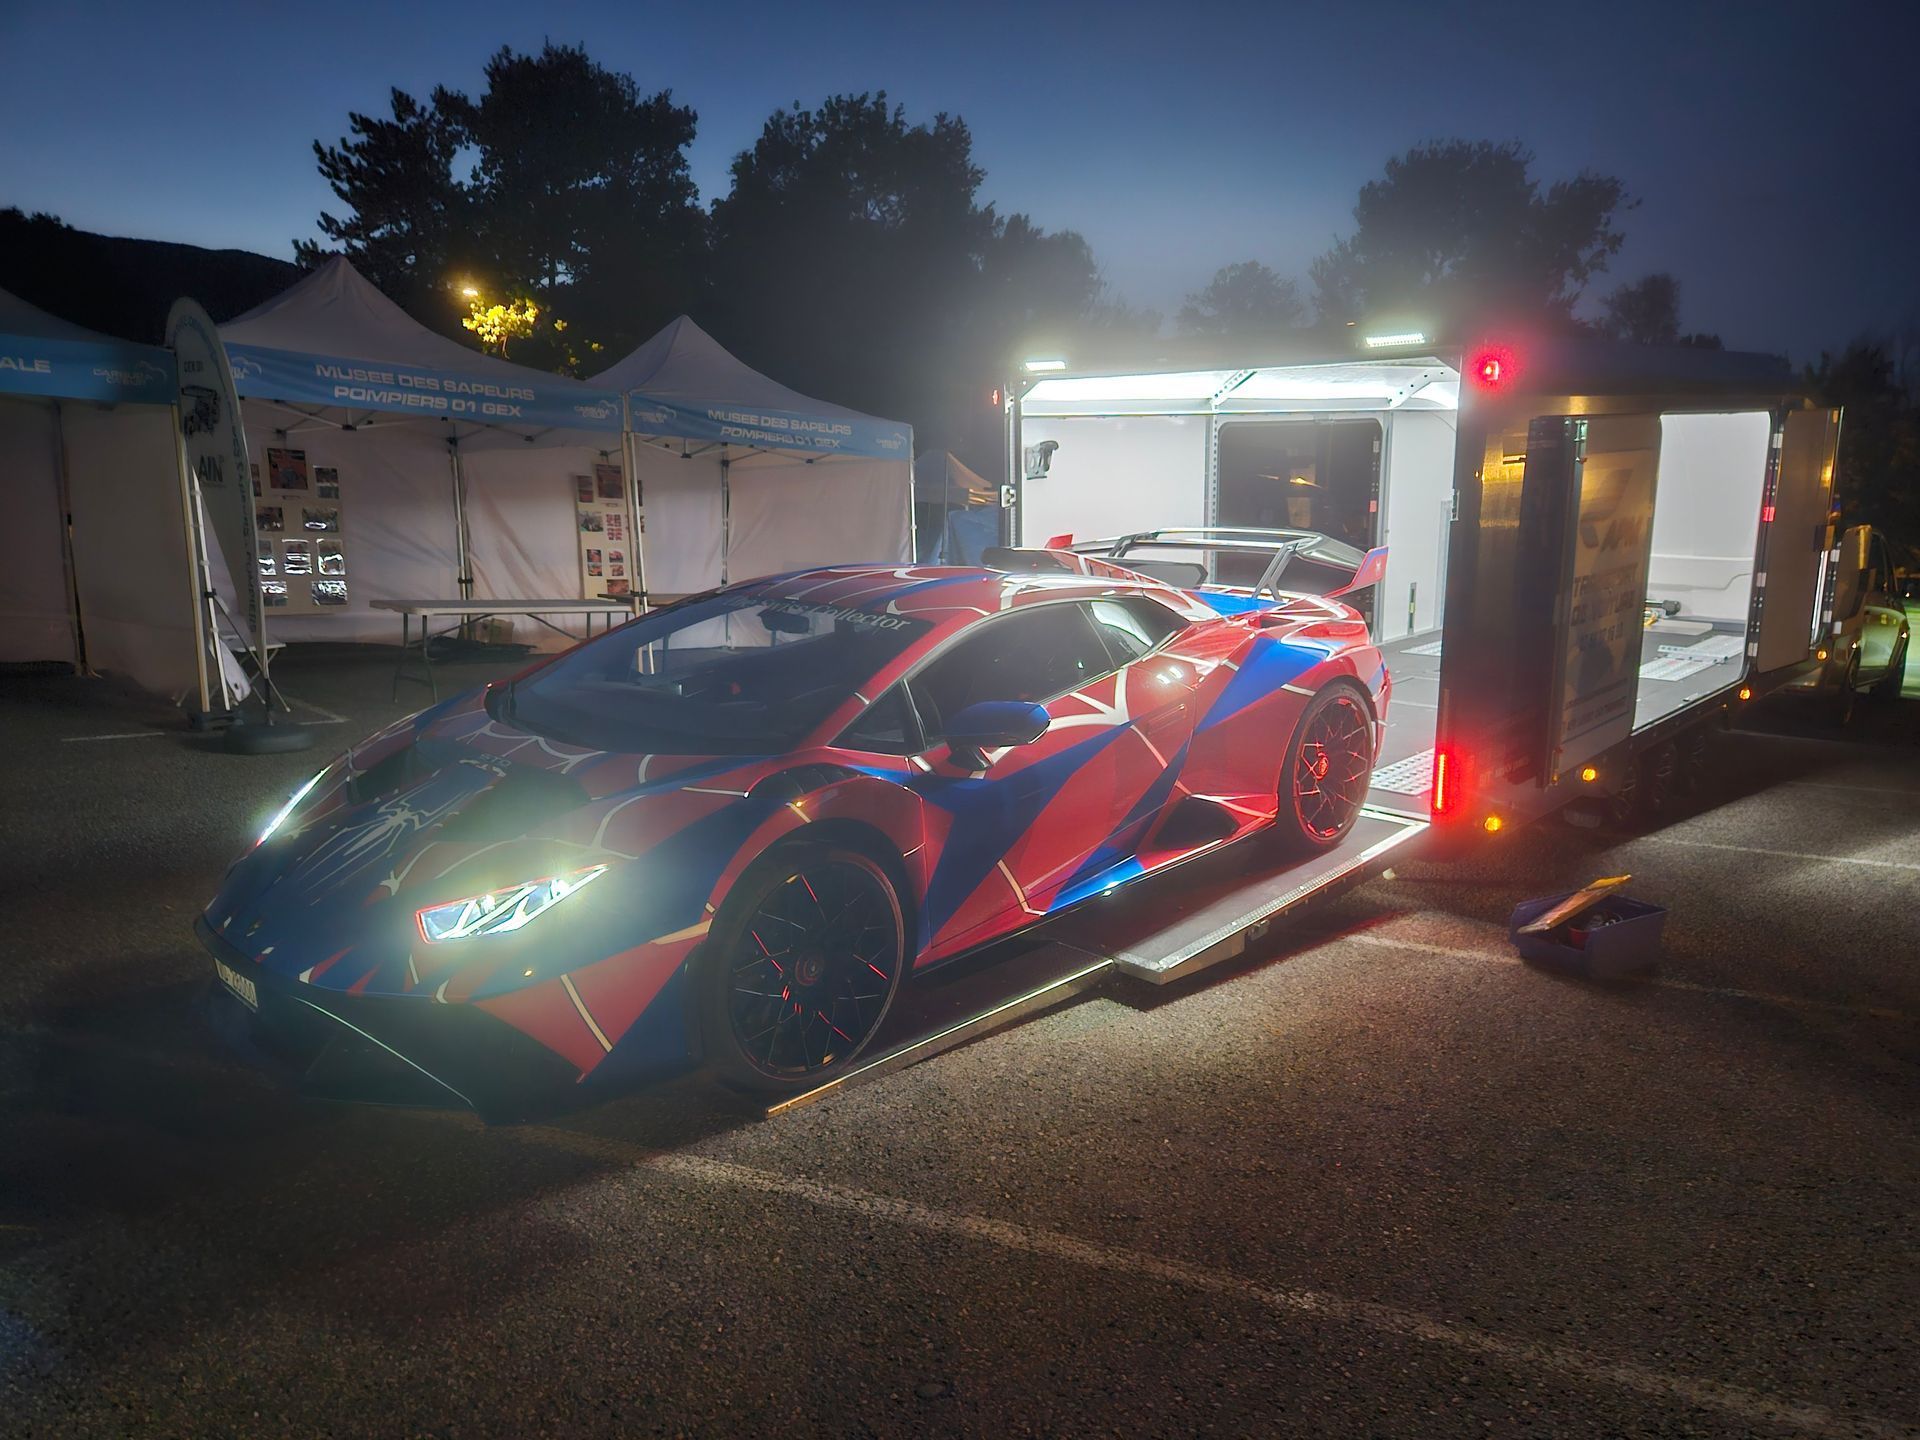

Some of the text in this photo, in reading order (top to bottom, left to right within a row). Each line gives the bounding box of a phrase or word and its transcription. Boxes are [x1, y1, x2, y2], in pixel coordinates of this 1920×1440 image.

[315, 364, 535, 401] MUSEE DES SAPEURS
[334, 385, 448, 409] POMPIERS
[482, 402, 522, 418] GEX
[707, 409, 852, 436] MUSEE DES SAPEURS
[719, 426, 794, 445] POMPIERS
[815, 437, 841, 449] GEX
[811, 604, 912, 630] Collector
